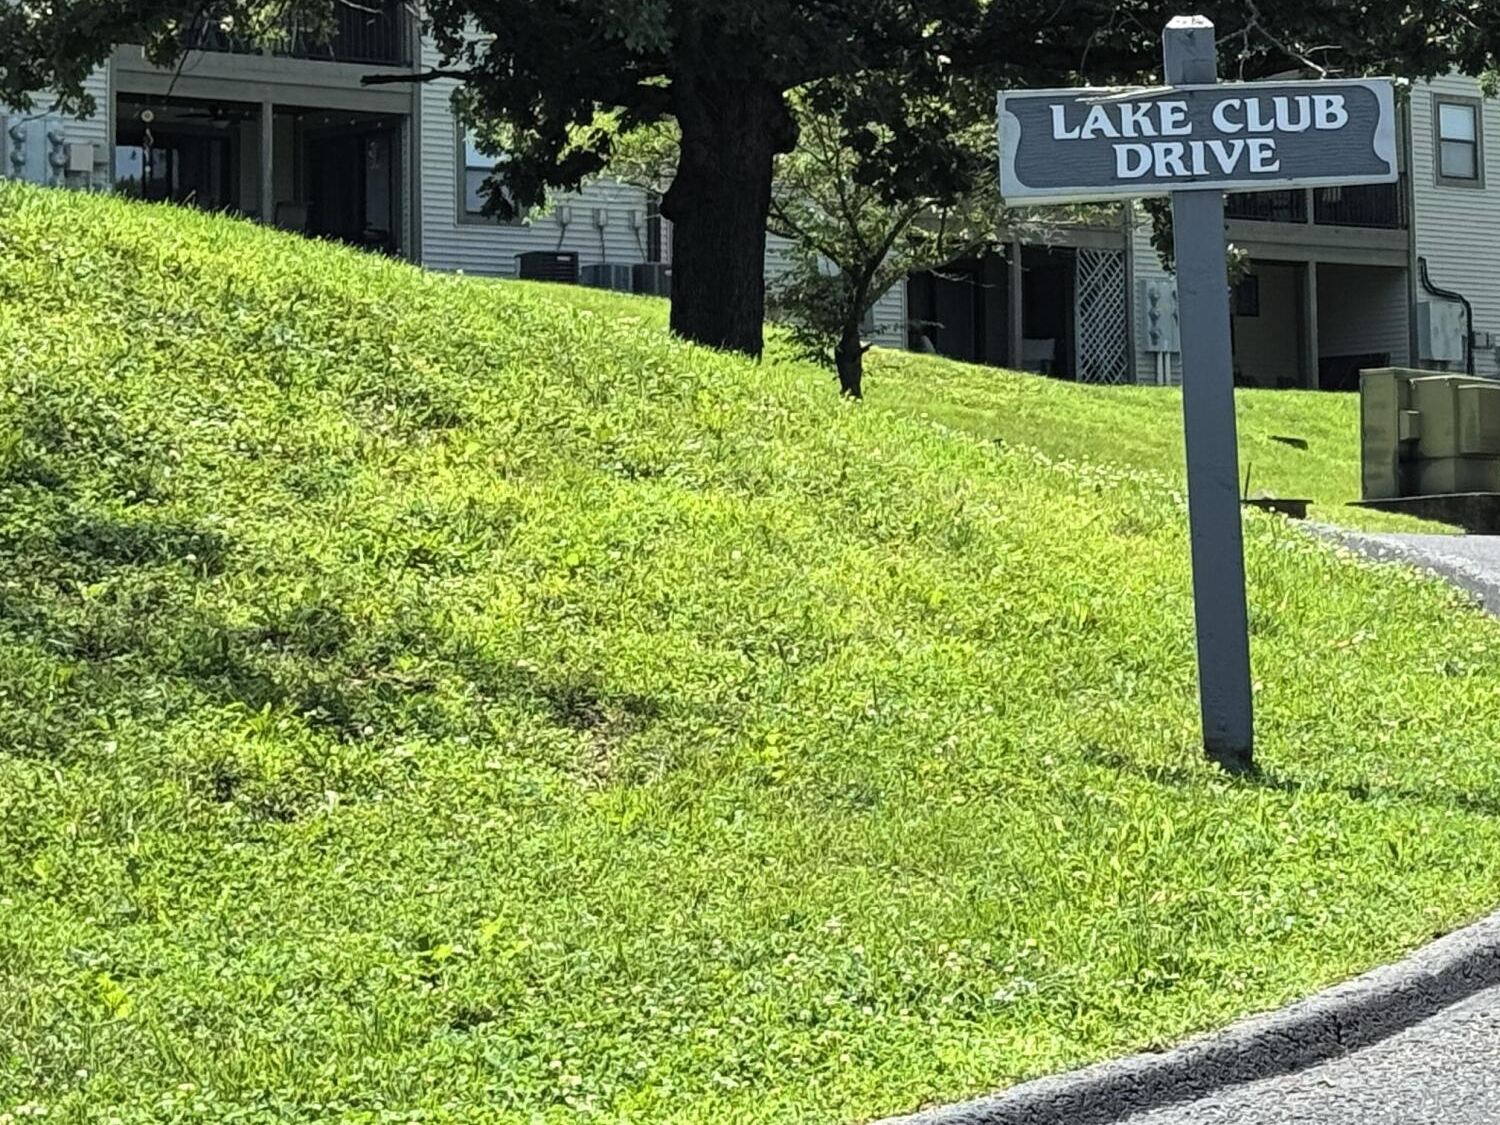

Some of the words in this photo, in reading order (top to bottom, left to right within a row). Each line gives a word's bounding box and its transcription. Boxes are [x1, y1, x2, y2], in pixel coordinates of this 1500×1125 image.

[1049, 101, 1192, 140] LAKE
[1212, 94, 1349, 133] CLUB
[1112, 138, 1280, 178] DRIVE
